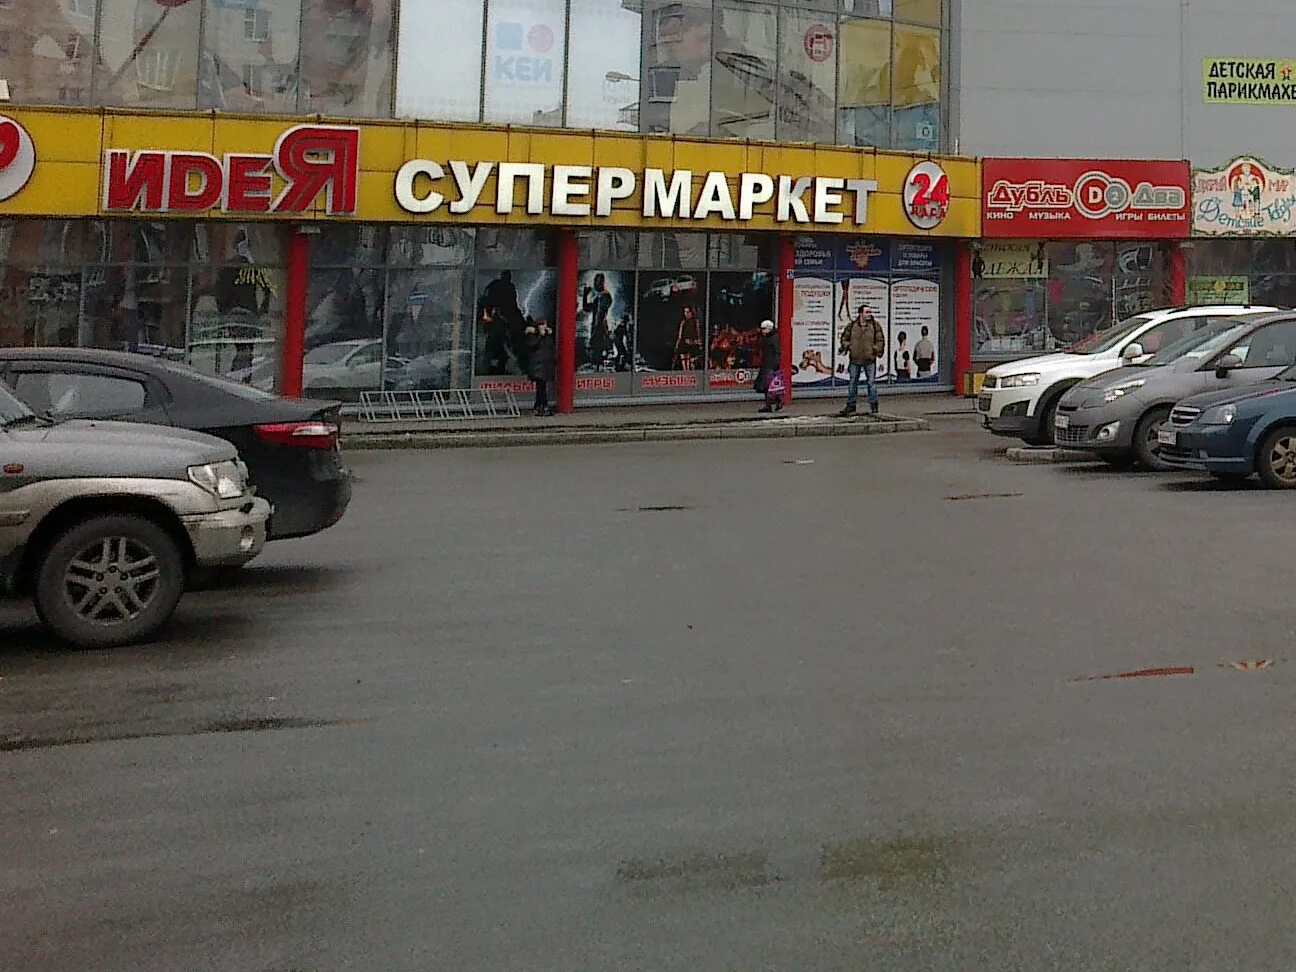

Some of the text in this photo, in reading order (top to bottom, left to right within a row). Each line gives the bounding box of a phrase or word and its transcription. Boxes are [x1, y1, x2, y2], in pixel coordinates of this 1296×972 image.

[1208, 62, 1275, 80] ДЕТСКАЯ
[394, 158, 879, 225] СУПЕРМАРКЕТ
[912, 173, 950, 206] 24
[990, 181, 1072, 209] Дубль
[1132, 183, 1184, 207] Два
[986, 212, 1013, 220] КИНО
[1029, 212, 1071, 220] МУЗЫКА
[576, 378, 615, 389] ИГРЫ
